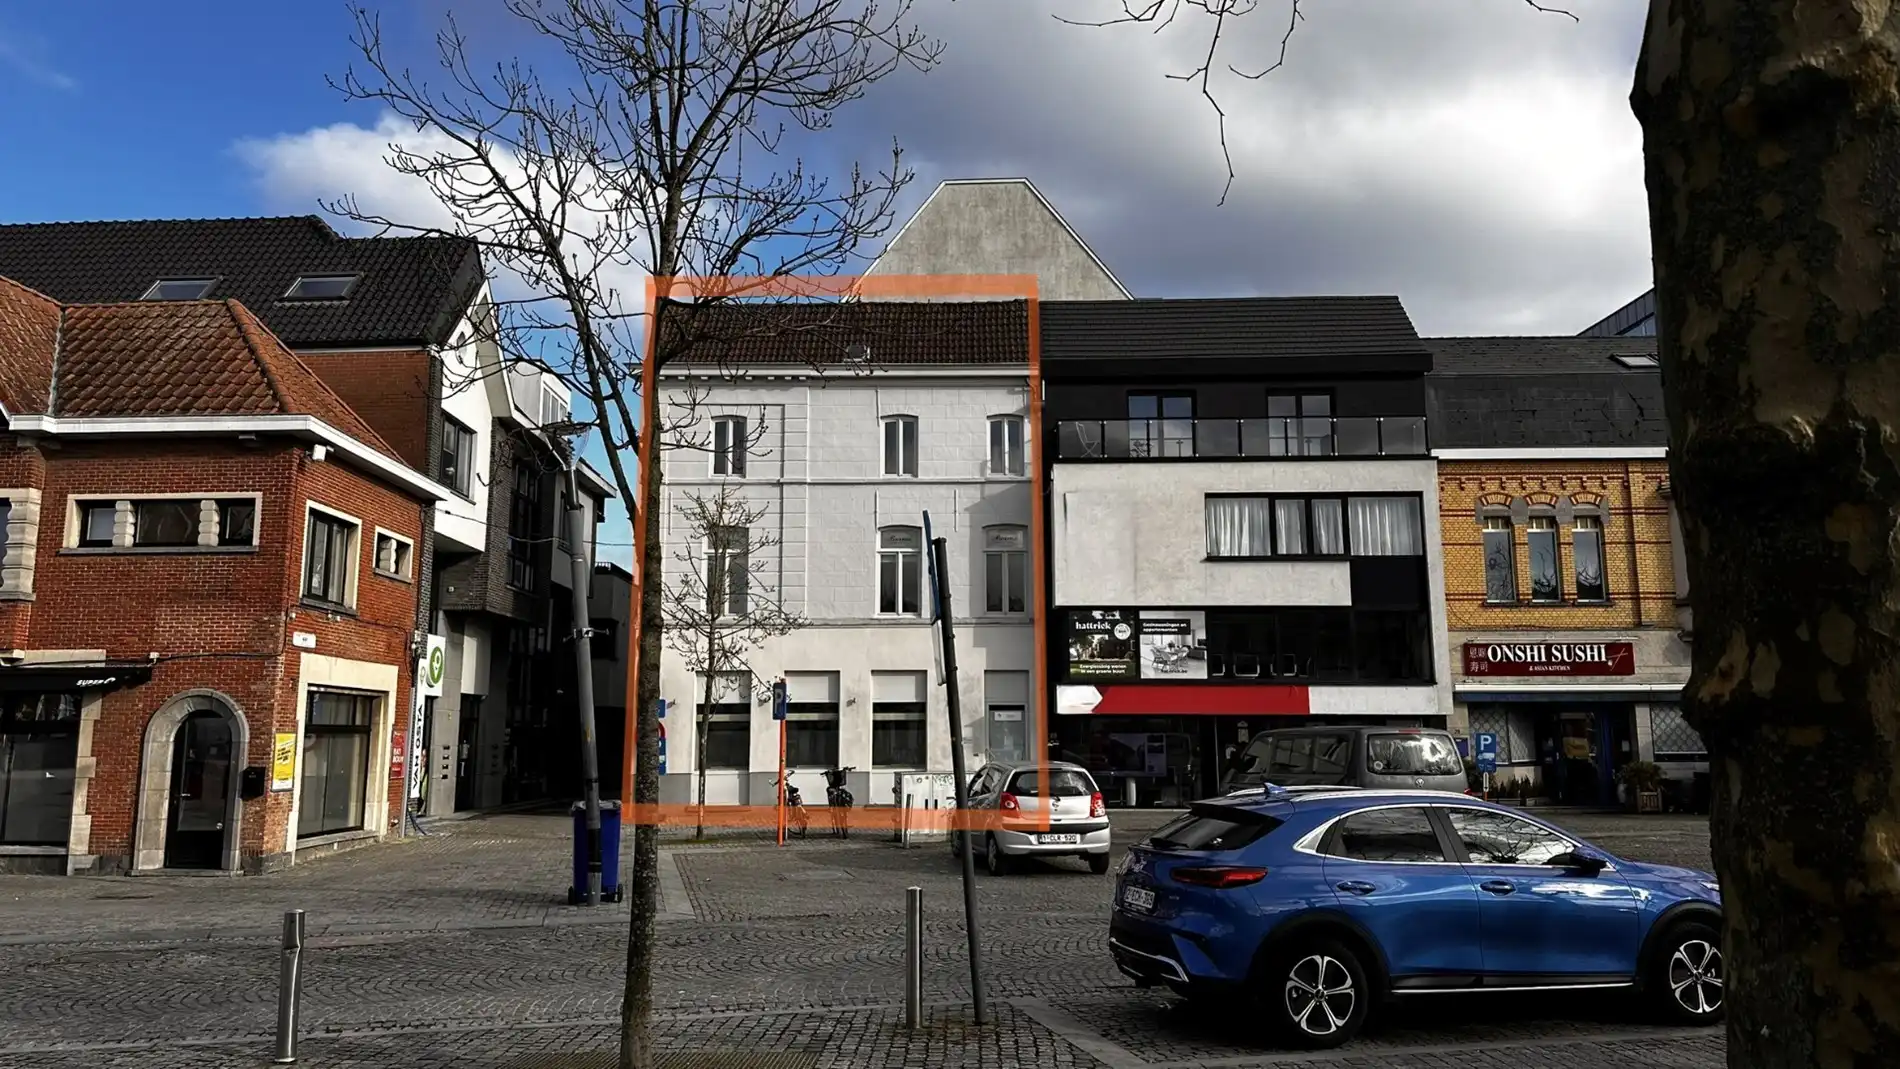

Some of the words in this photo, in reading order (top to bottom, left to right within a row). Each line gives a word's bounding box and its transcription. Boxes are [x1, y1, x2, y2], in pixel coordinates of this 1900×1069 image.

[1075, 621, 1111, 630] hattrick
[1487, 644, 1547, 662] ONSHI
[1551, 644, 1607, 662] SUSHI
[415, 704, 423, 749] OSTA
[1480, 735, 1492, 751] P
